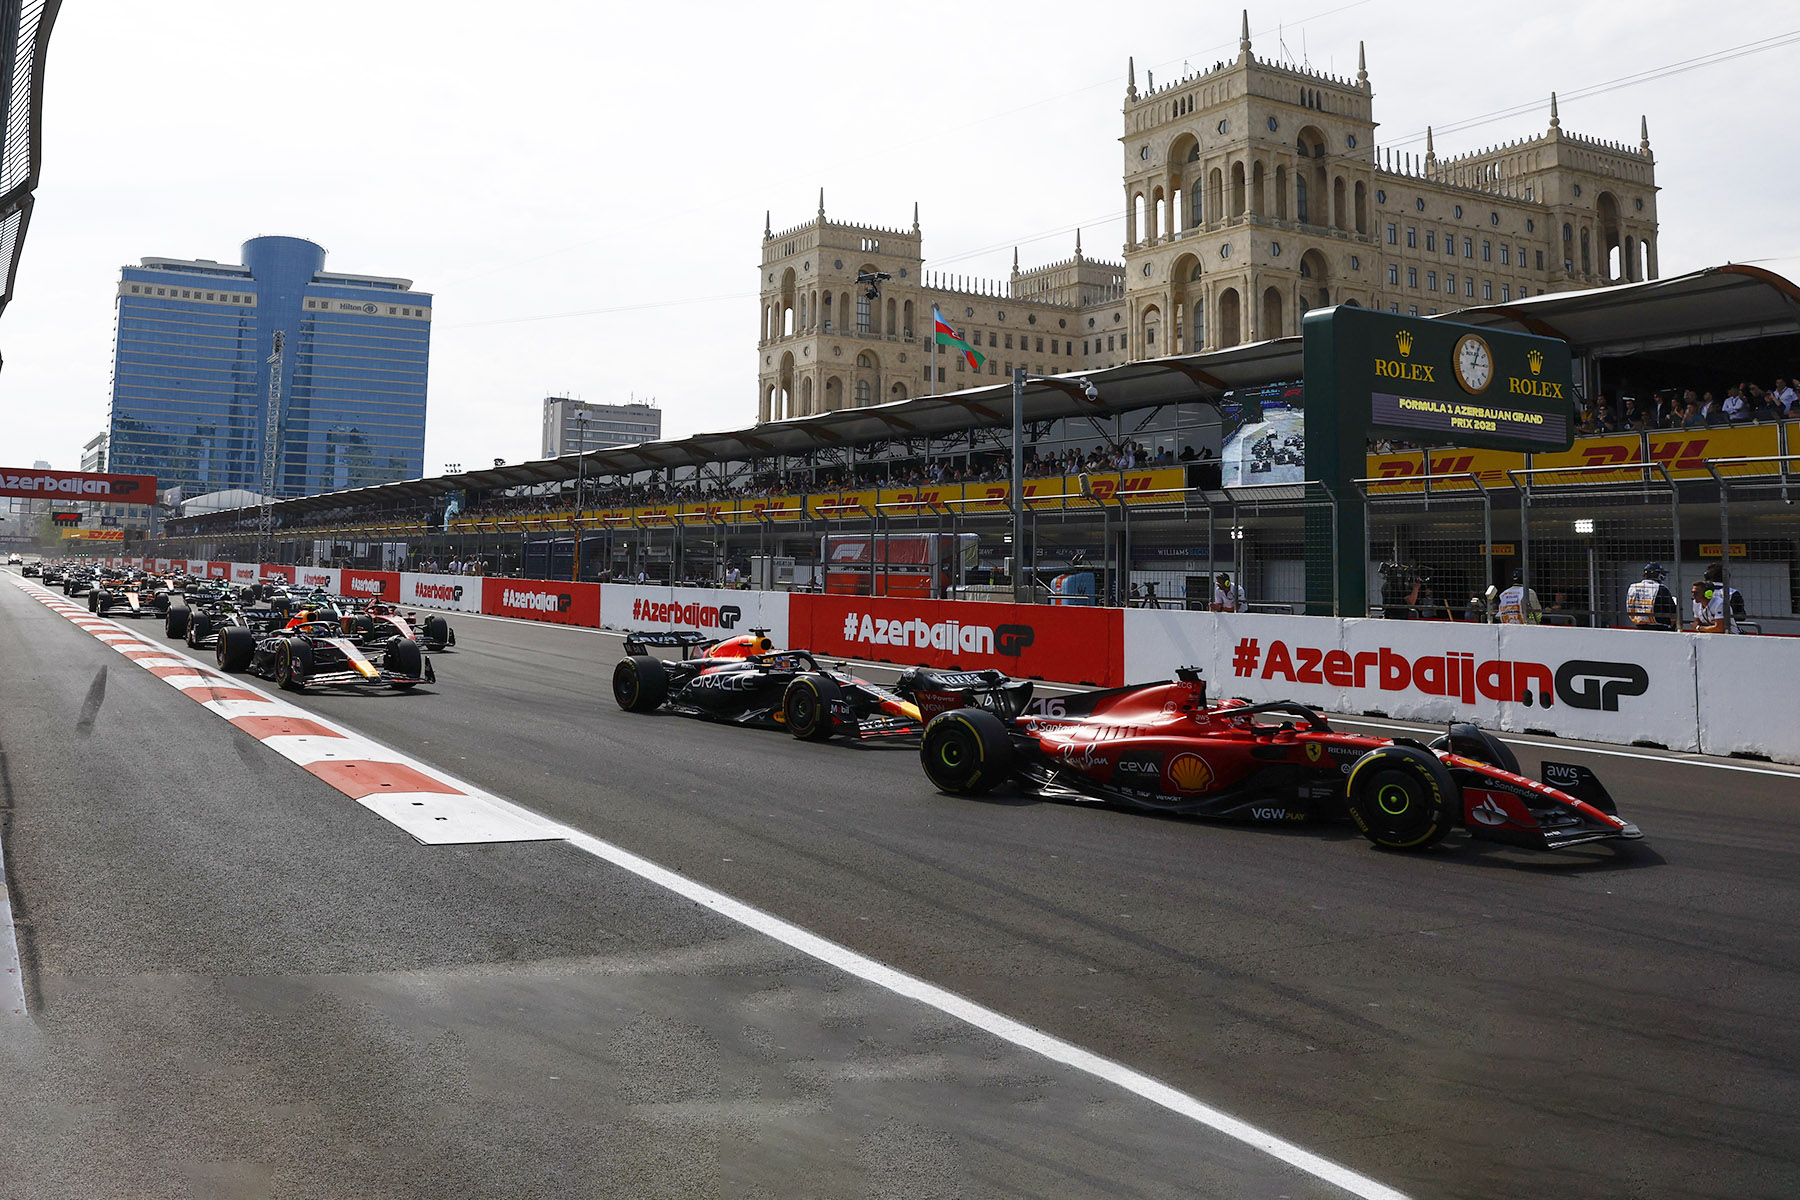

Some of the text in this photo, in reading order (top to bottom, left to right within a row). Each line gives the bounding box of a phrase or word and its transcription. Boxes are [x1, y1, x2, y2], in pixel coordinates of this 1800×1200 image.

[340, 303, 362, 312] Hilton
[1374, 358, 1435, 382] ROLEX
[1509, 377, 1564, 399] ROLEX
[1399, 398, 1543, 425] FORMULA 1 AZERBAIJAN GRAND
[1451, 416, 1496, 432] PRIX 2023
[1581, 439, 1709, 475] DHL
[1377, 455, 1480, 486] DHL
[1091, 477, 1153, 500] DHL
[822, 497, 864, 514] DHL
[897, 492, 942, 511] DHL
[415, 582, 463, 601] #AzerbaijanGP
[502, 588, 571, 613] #AzerbaijanGP
[633, 599, 741, 629] #AzerbaijanGP
[843, 612, 1035, 657] #AzerbaijanGP
[691, 674, 758, 691] ORACLE
[1233, 637, 1649, 712] #AzerbaijanGP
[922, 703, 945, 712] VGW
[925, 694, 955, 702] V-Power
[1032, 698, 1067, 719] 16
[1039, 721, 1089, 732] Santander
[1327, 746, 1364, 756] RICHARD
[1547, 765, 1578, 778] aws
[1416, 764, 1442, 804] ZERO
[1494, 780, 1539, 800] Santander
[1252, 808, 1285, 819] VGW
